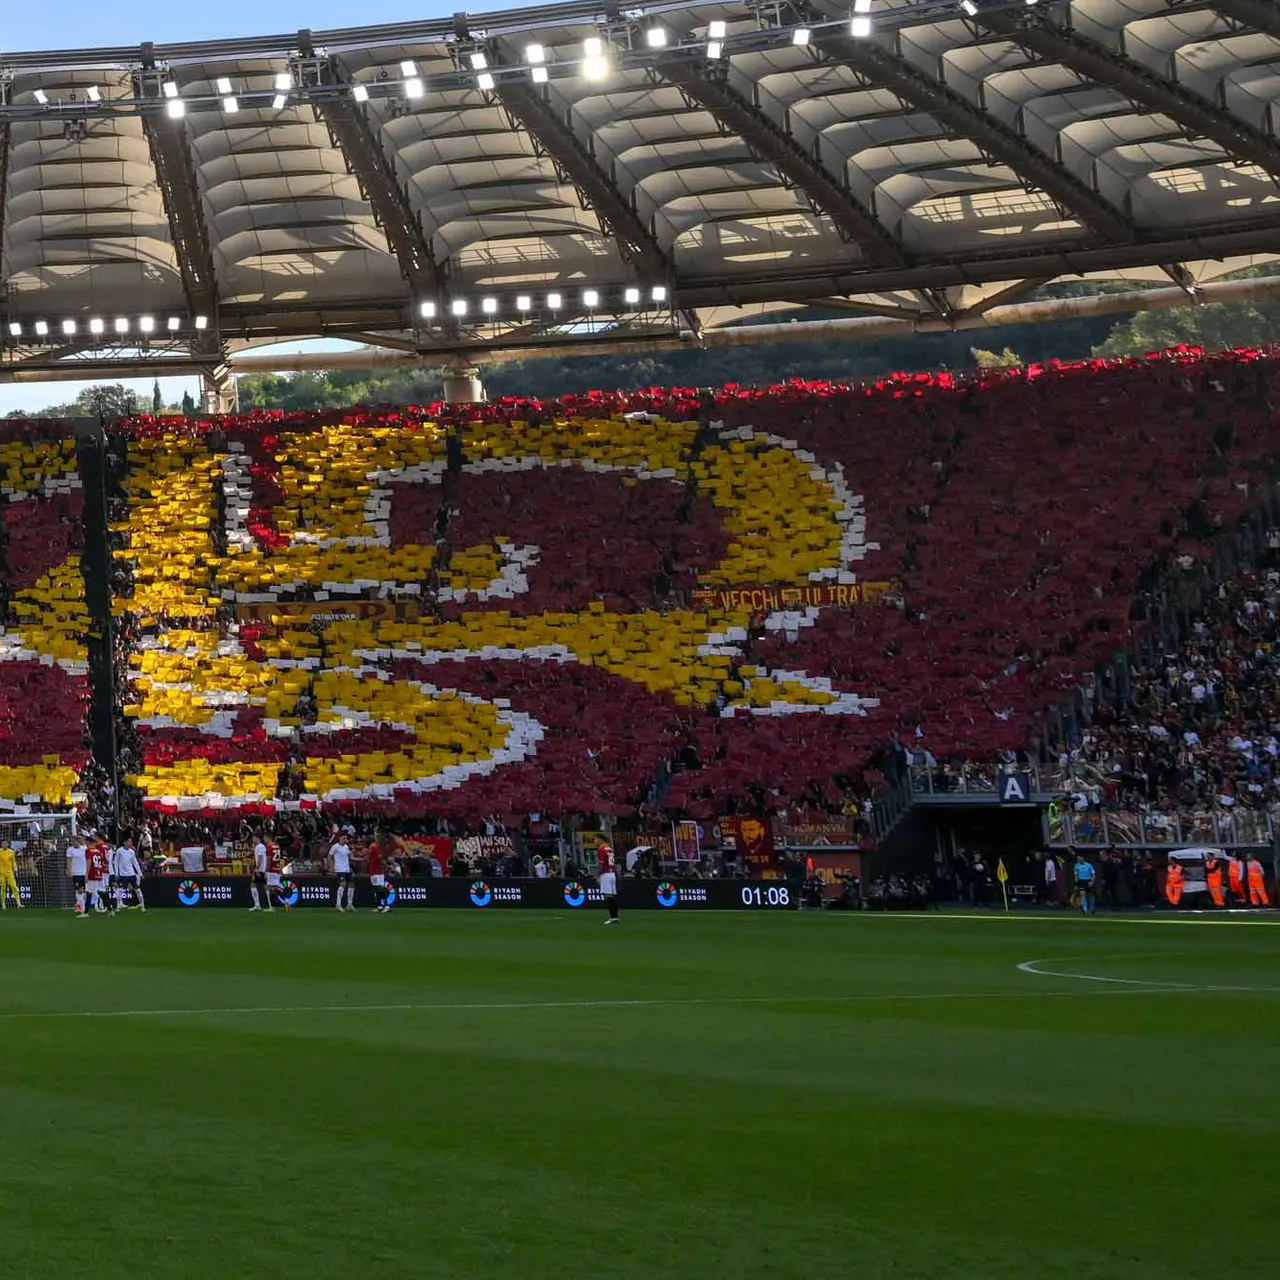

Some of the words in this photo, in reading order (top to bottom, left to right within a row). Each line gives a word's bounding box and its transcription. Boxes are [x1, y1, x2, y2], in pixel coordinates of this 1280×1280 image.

[719, 588, 781, 611] VECCHI
[1003, 777, 1026, 800] A
[741, 887, 789, 905] 01:08
